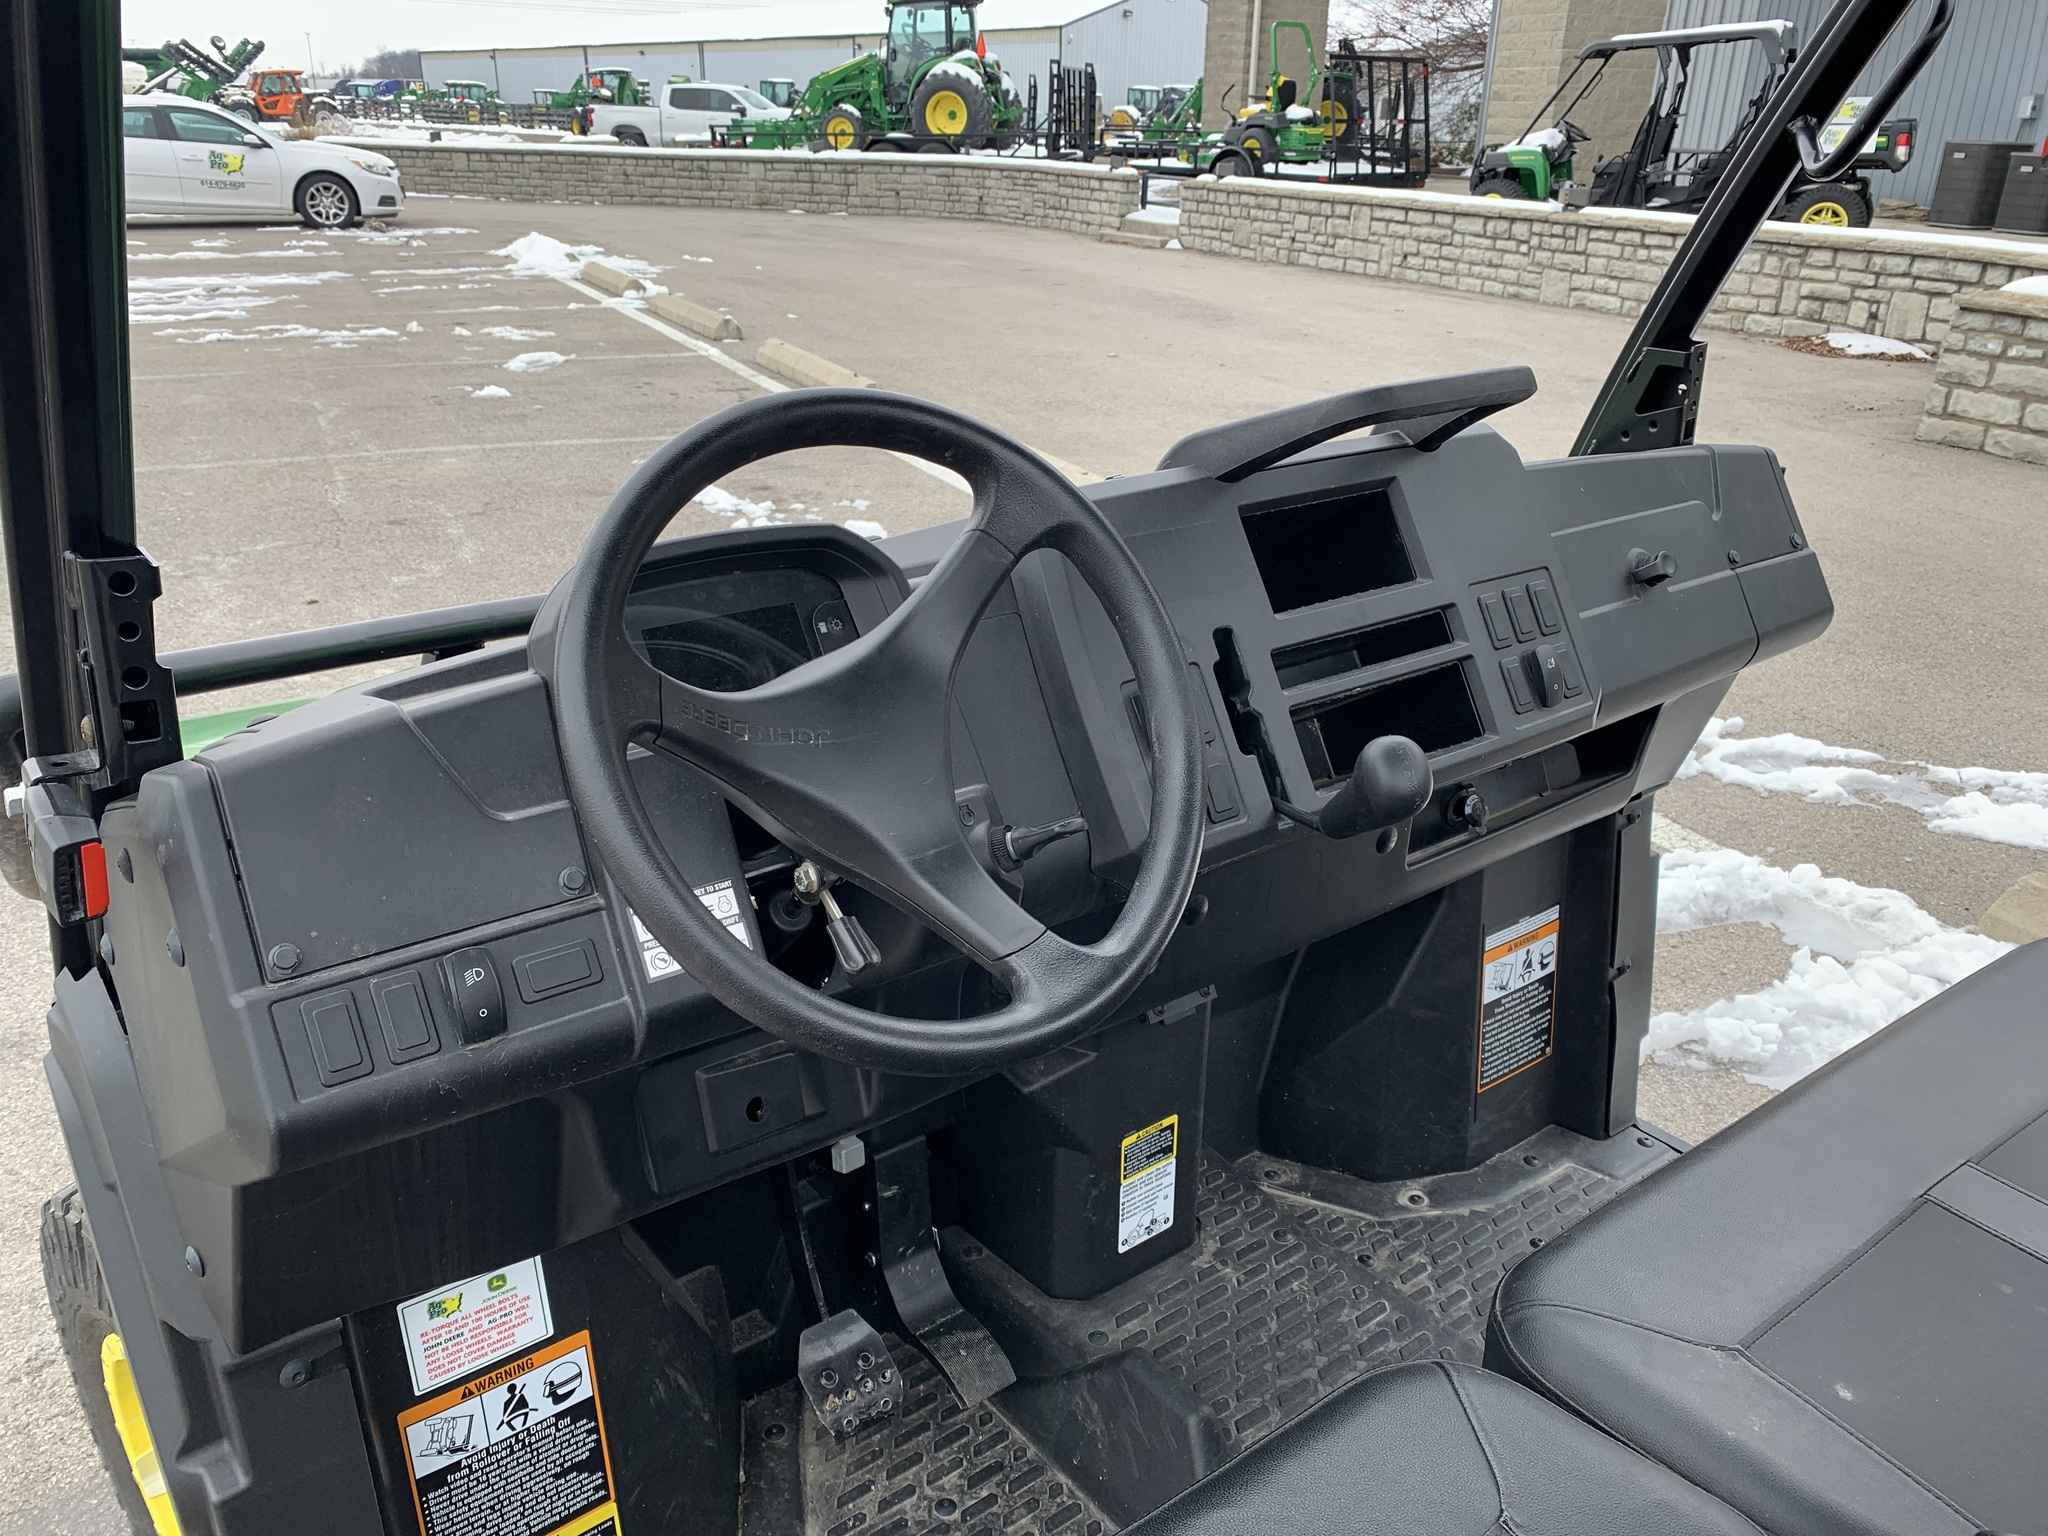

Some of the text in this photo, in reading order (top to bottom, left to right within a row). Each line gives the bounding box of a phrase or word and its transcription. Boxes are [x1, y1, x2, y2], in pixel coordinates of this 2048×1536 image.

[210, 150, 227, 161] Ag-
[210, 160, 228, 169] Pro
[706, 886, 714, 894] TO
[714, 880, 732, 890] START
[722, 916, 739, 926] SHIFT
[1514, 932, 1539, 949] WARNING
[1142, 1122, 1163, 1136] CAUTION
[420, 1293, 518, 1338] RE-TORQUE ALL WHEEL BOLTS
[428, 1300, 446, 1313] Ag-
[429, 1308, 447, 1320] Pro
[481, 1286, 517, 1304] JOHN DEERE
[422, 1333, 442, 1346] AFTER
[454, 1322, 469, 1332] AND
[471, 1316, 482, 1324] 100
[484, 1305, 507, 1319] HOURS
[519, 1295, 532, 1304] USE.
[423, 1304, 529, 1353] JOHN DEERE AND AG-PRO WILL
[425, 1350, 439, 1360] NOT
[451, 1338, 468, 1348] HELD
[470, 1318, 513, 1340] RESPONSIBLE
[514, 1312, 527, 1321] FOR
[426, 1316, 533, 1367] ANY LOOSE WHEELS. WARRANTY
[428, 1332, 515, 1374] DOES NOT COVER DAMAGE
[429, 1366, 456, 1381] CAUSED
[468, 1351, 488, 1364] LOOSE
[490, 1339, 517, 1354] WHEELS.
[474, 1356, 535, 1394] WARNING
[427, 1418, 589, 1501] Watch video and read operator's manual before use.
[428, 1491, 450, 1507] Driver
[450, 1483, 468, 1497] must
[468, 1478, 478, 1488] be
[478, 1473, 487, 1483] 16
[488, 1466, 506, 1480] years
[506, 1459, 517, 1469] old
[517, 1451, 532, 1464] with
[538, 1441, 554, 1454] valid
[554, 1431, 573, 1446] driver
[573, 1419, 598, 1436] license.
[447, 1416, 571, 1483] from Rollover or Falling Off
[460, 1415, 556, 1468] Avoid Injury or Death
[430, 1430, 589, 1514] Never drive under the influence of alcohol or drugs.
[431, 1432, 599, 1521] Vehicle is equipped with seatbelts and side doors or nets.
[432, 1440, 597, 1527] This safety equipment must be used by all occupants.
[434, 1519, 453, 1534] Wear
[453, 1505, 480, 1524] helmets
[480, 1496, 499, 1510] when
[499, 1485, 522, 1502] driving
[563, 1460, 572, 1469] on
[572, 1450, 590, 1465] rough
